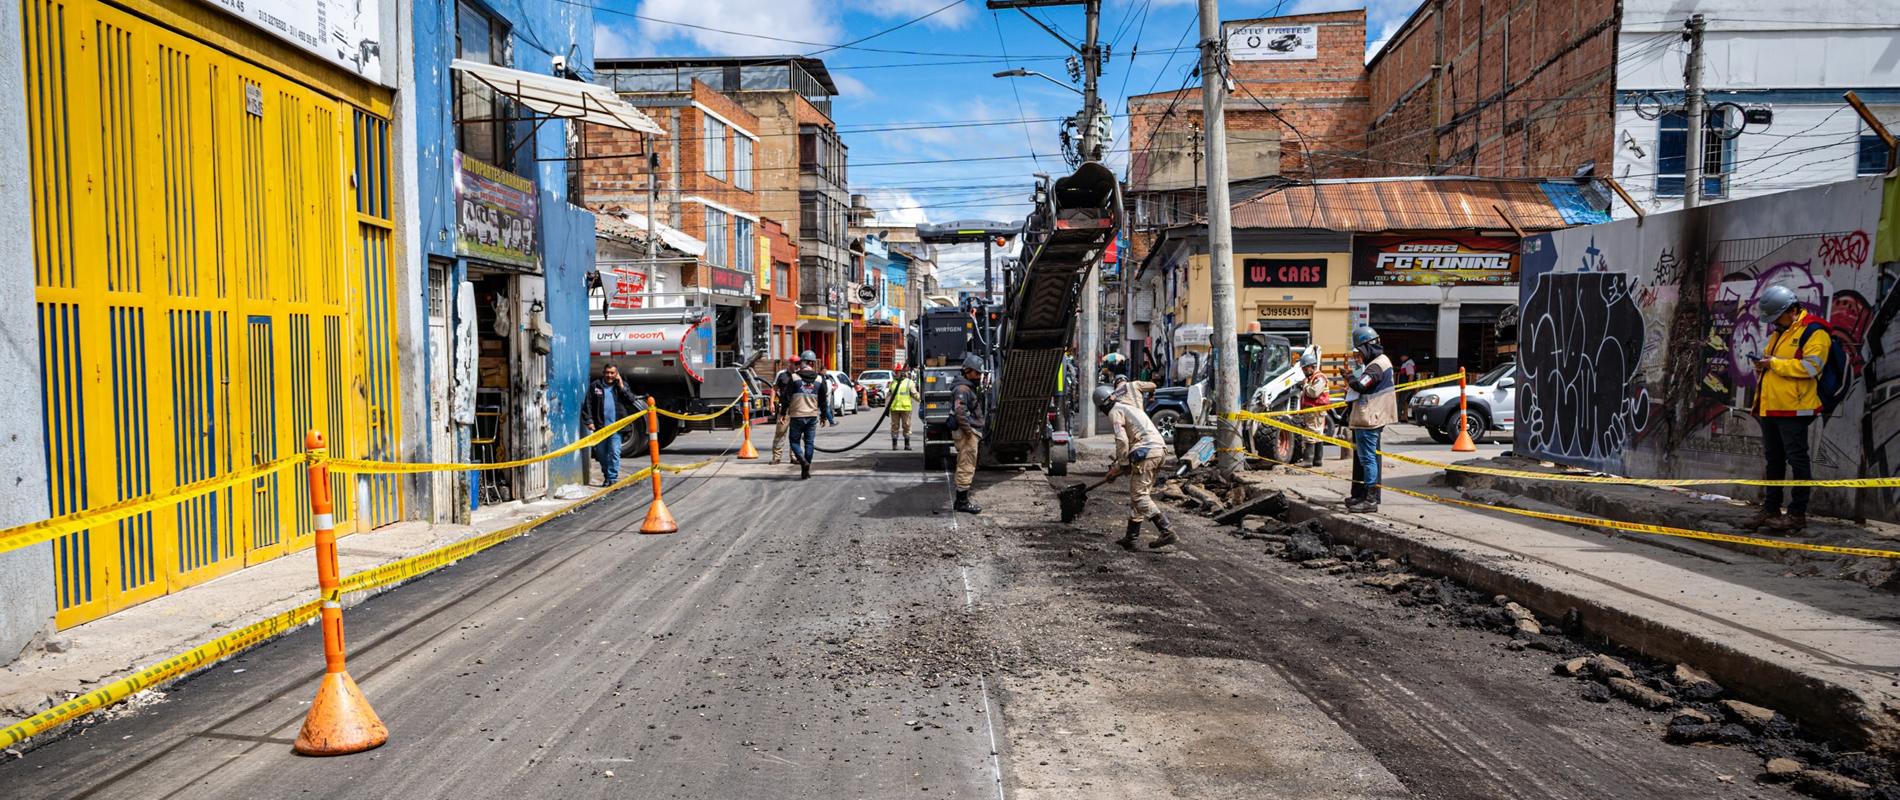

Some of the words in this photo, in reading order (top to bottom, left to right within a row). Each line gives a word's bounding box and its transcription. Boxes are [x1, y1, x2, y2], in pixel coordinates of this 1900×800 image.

[1234, 27, 1264, 35] AUTO
[1267, 26, 1312, 34] PARTES
[1398, 244, 1460, 253] CARS
[1417, 253, 1511, 269] TUNING
[1250, 266, 1271, 282] W.
[1278, 266, 1320, 282] CARS
[1267, 307, 1309, 316] 3195645314
[597, 332, 621, 340] UMV
